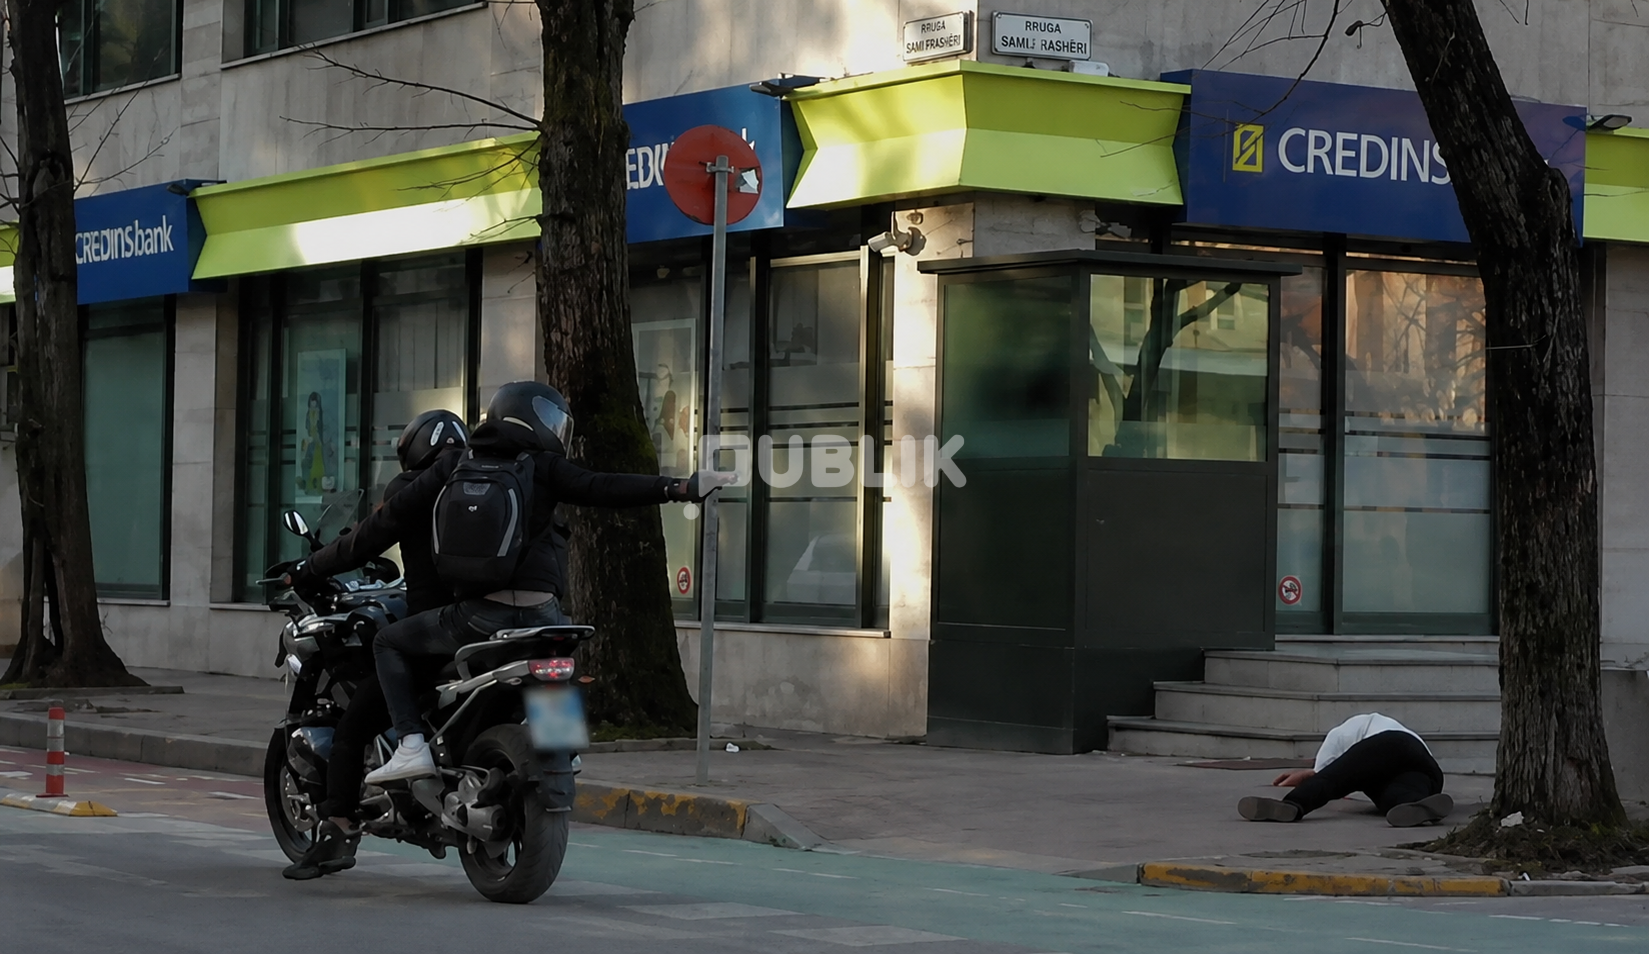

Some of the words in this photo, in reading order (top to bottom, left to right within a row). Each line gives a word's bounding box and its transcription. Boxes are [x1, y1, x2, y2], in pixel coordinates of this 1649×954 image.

[921, 20, 946, 34] RRUGA
[1025, 20, 1061, 34] RRUGA
[906, 40, 925, 54] SAMI
[1001, 35, 1029, 49] SAMI
